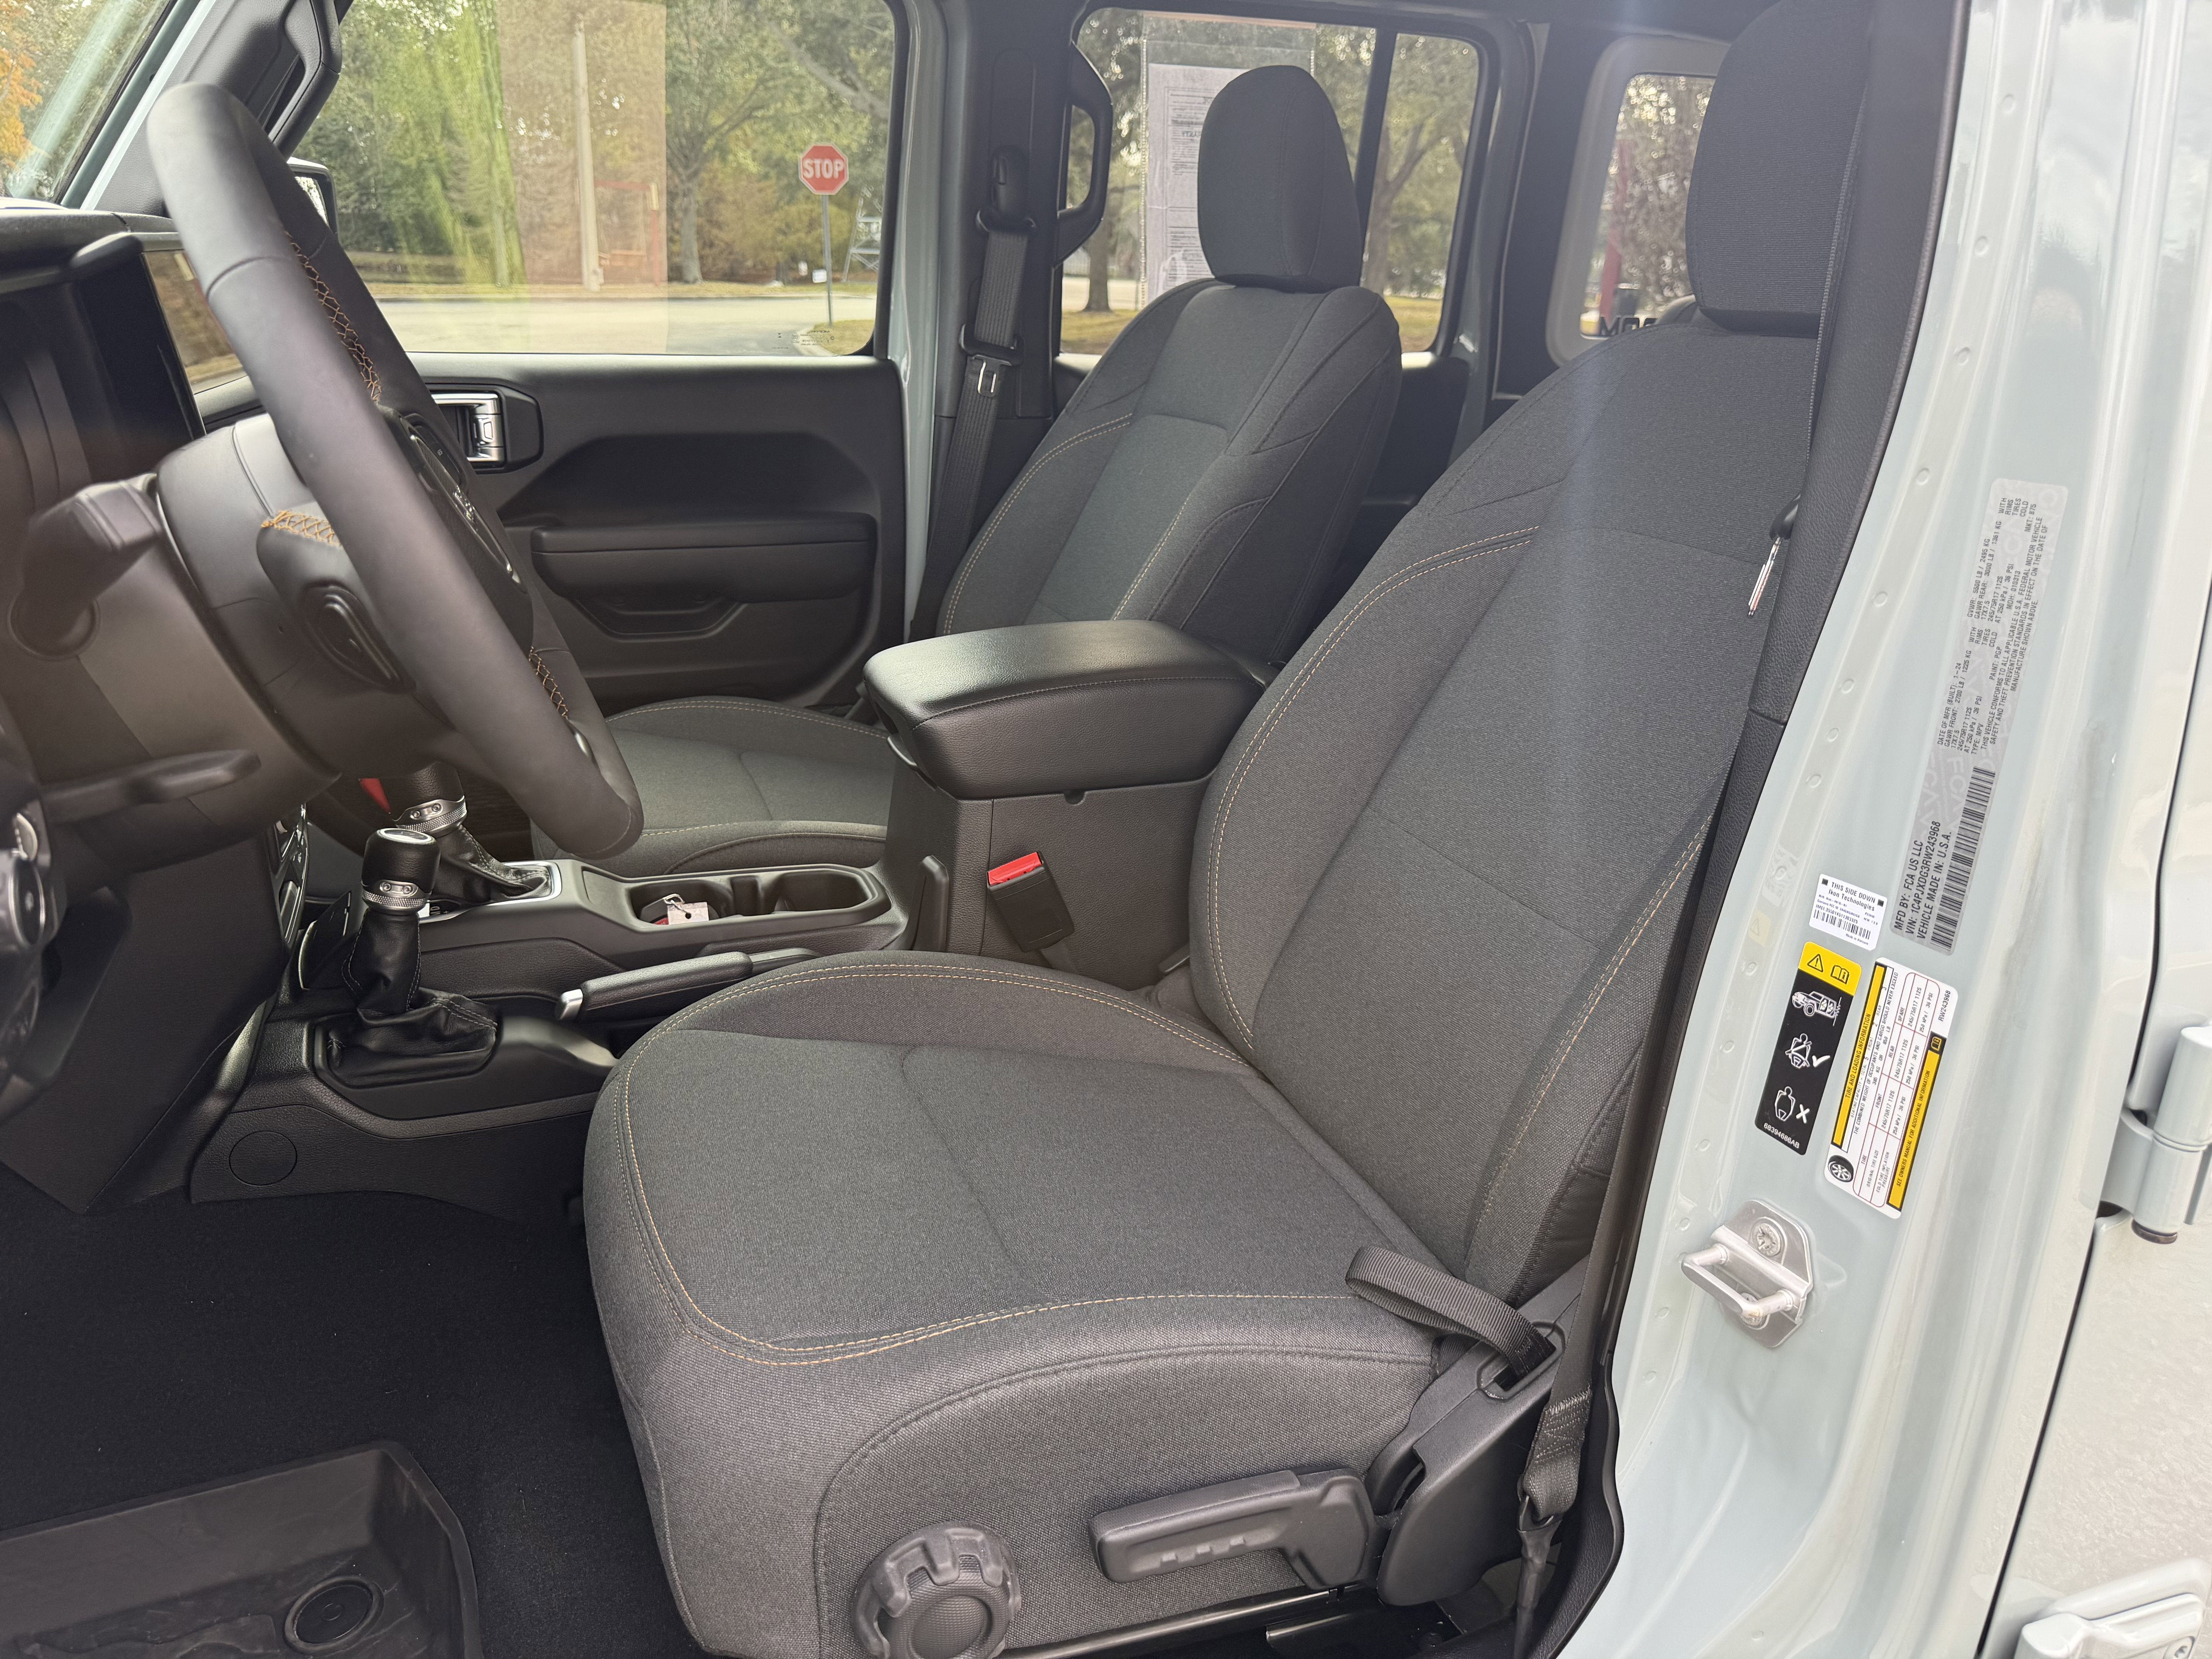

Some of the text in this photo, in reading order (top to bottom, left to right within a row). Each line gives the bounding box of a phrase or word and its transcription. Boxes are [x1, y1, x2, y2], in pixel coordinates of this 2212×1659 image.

[803, 158, 845, 179] STOP
[1998, 498, 2006, 513] WITH
[2031, 517, 2042, 542] VEHICLE
[2037, 535, 2045, 551] DATE
[1981, 500, 2013, 619] 17X7.5 RIMS
[1987, 591, 1999, 622] 245/75R17
[2011, 498, 2021, 515] TIRES
[1995, 615, 2001, 623] AT
[2019, 501, 2028, 517] COLD
[2025, 544, 2036, 566] MOTOR
[2033, 553, 2041, 565] THE
[2018, 568, 2030, 595] FEDERAL
[2031, 568, 2038, 576] ON
[1978, 580, 1988, 599] REAR:
[2025, 578, 2035, 600] EFFECT
[1967, 597, 1976, 617] GVWR:
[1974, 601, 1983, 618] GAWR
[2013, 598, 2023, 616] U.S.A.
[1971, 737, 1980, 754] TYPE:
[1989, 660, 1999, 680] PAINT:
[2006, 593, 2015, 609] MDH:
[2011, 570, 2020, 591] 010313
[2025, 516, 2033, 532] MKT:
[2004, 618, 2018, 654] APPLICABLE
[2013, 611, 2027, 647] STANDARDS
[2010, 600, 2038, 691] MANUFACTURE SHOWN ABOVE.
[2004, 649, 2018, 686] PREVENTION
[1951, 629, 1983, 747] 17X7.5 RIMS
[1957, 721, 1968, 750] 245/75R17
[1982, 629, 1990, 645] TIRES
[1964, 745, 1970, 753] AT
[1989, 632, 1997, 647] COLD
[1990, 678, 2003, 709] CONFORMS
[1999, 687, 2008, 706] THEFT
[1937, 730, 1946, 745] DATE
[1947, 682, 1957, 704] (BUILT):
[1944, 730, 1953, 747] GAWR
[1949, 706, 1958, 727] FRONT:
[1984, 711, 1995, 734] VEHICLE
[1980, 737, 1989, 749] THIS
[1990, 722, 1999, 744] SAFETY
[1832, 882, 1875, 903] THIS SIDE DOWN
[1894, 840, 1923, 930] MFD BY: FCA US LLC
[1905, 821, 1940, 934] VIN: 1C4PJXDG3RW243968
[1917, 832, 1951, 938] VEHICLE MADE IN: U.S.A.
[1829, 889, 1839, 897] Ikon
[1842, 893, 1874, 911] Technologies
[1938, 990, 1950, 1021] RW243968
[1852, 1050, 1861, 1073] LOADING
[1858, 1013, 1870, 1049] INFORMATION
[1856, 1103, 1864, 1125] COMBINED
[1868, 1052, 1878, 1077] OCCUPANTS
[1911, 1103, 1922, 1128] ADDITIONAL
[1918, 1070, 1930, 1101] INFORMATION
[1764, 1123, 1799, 1148] 68394686AB
